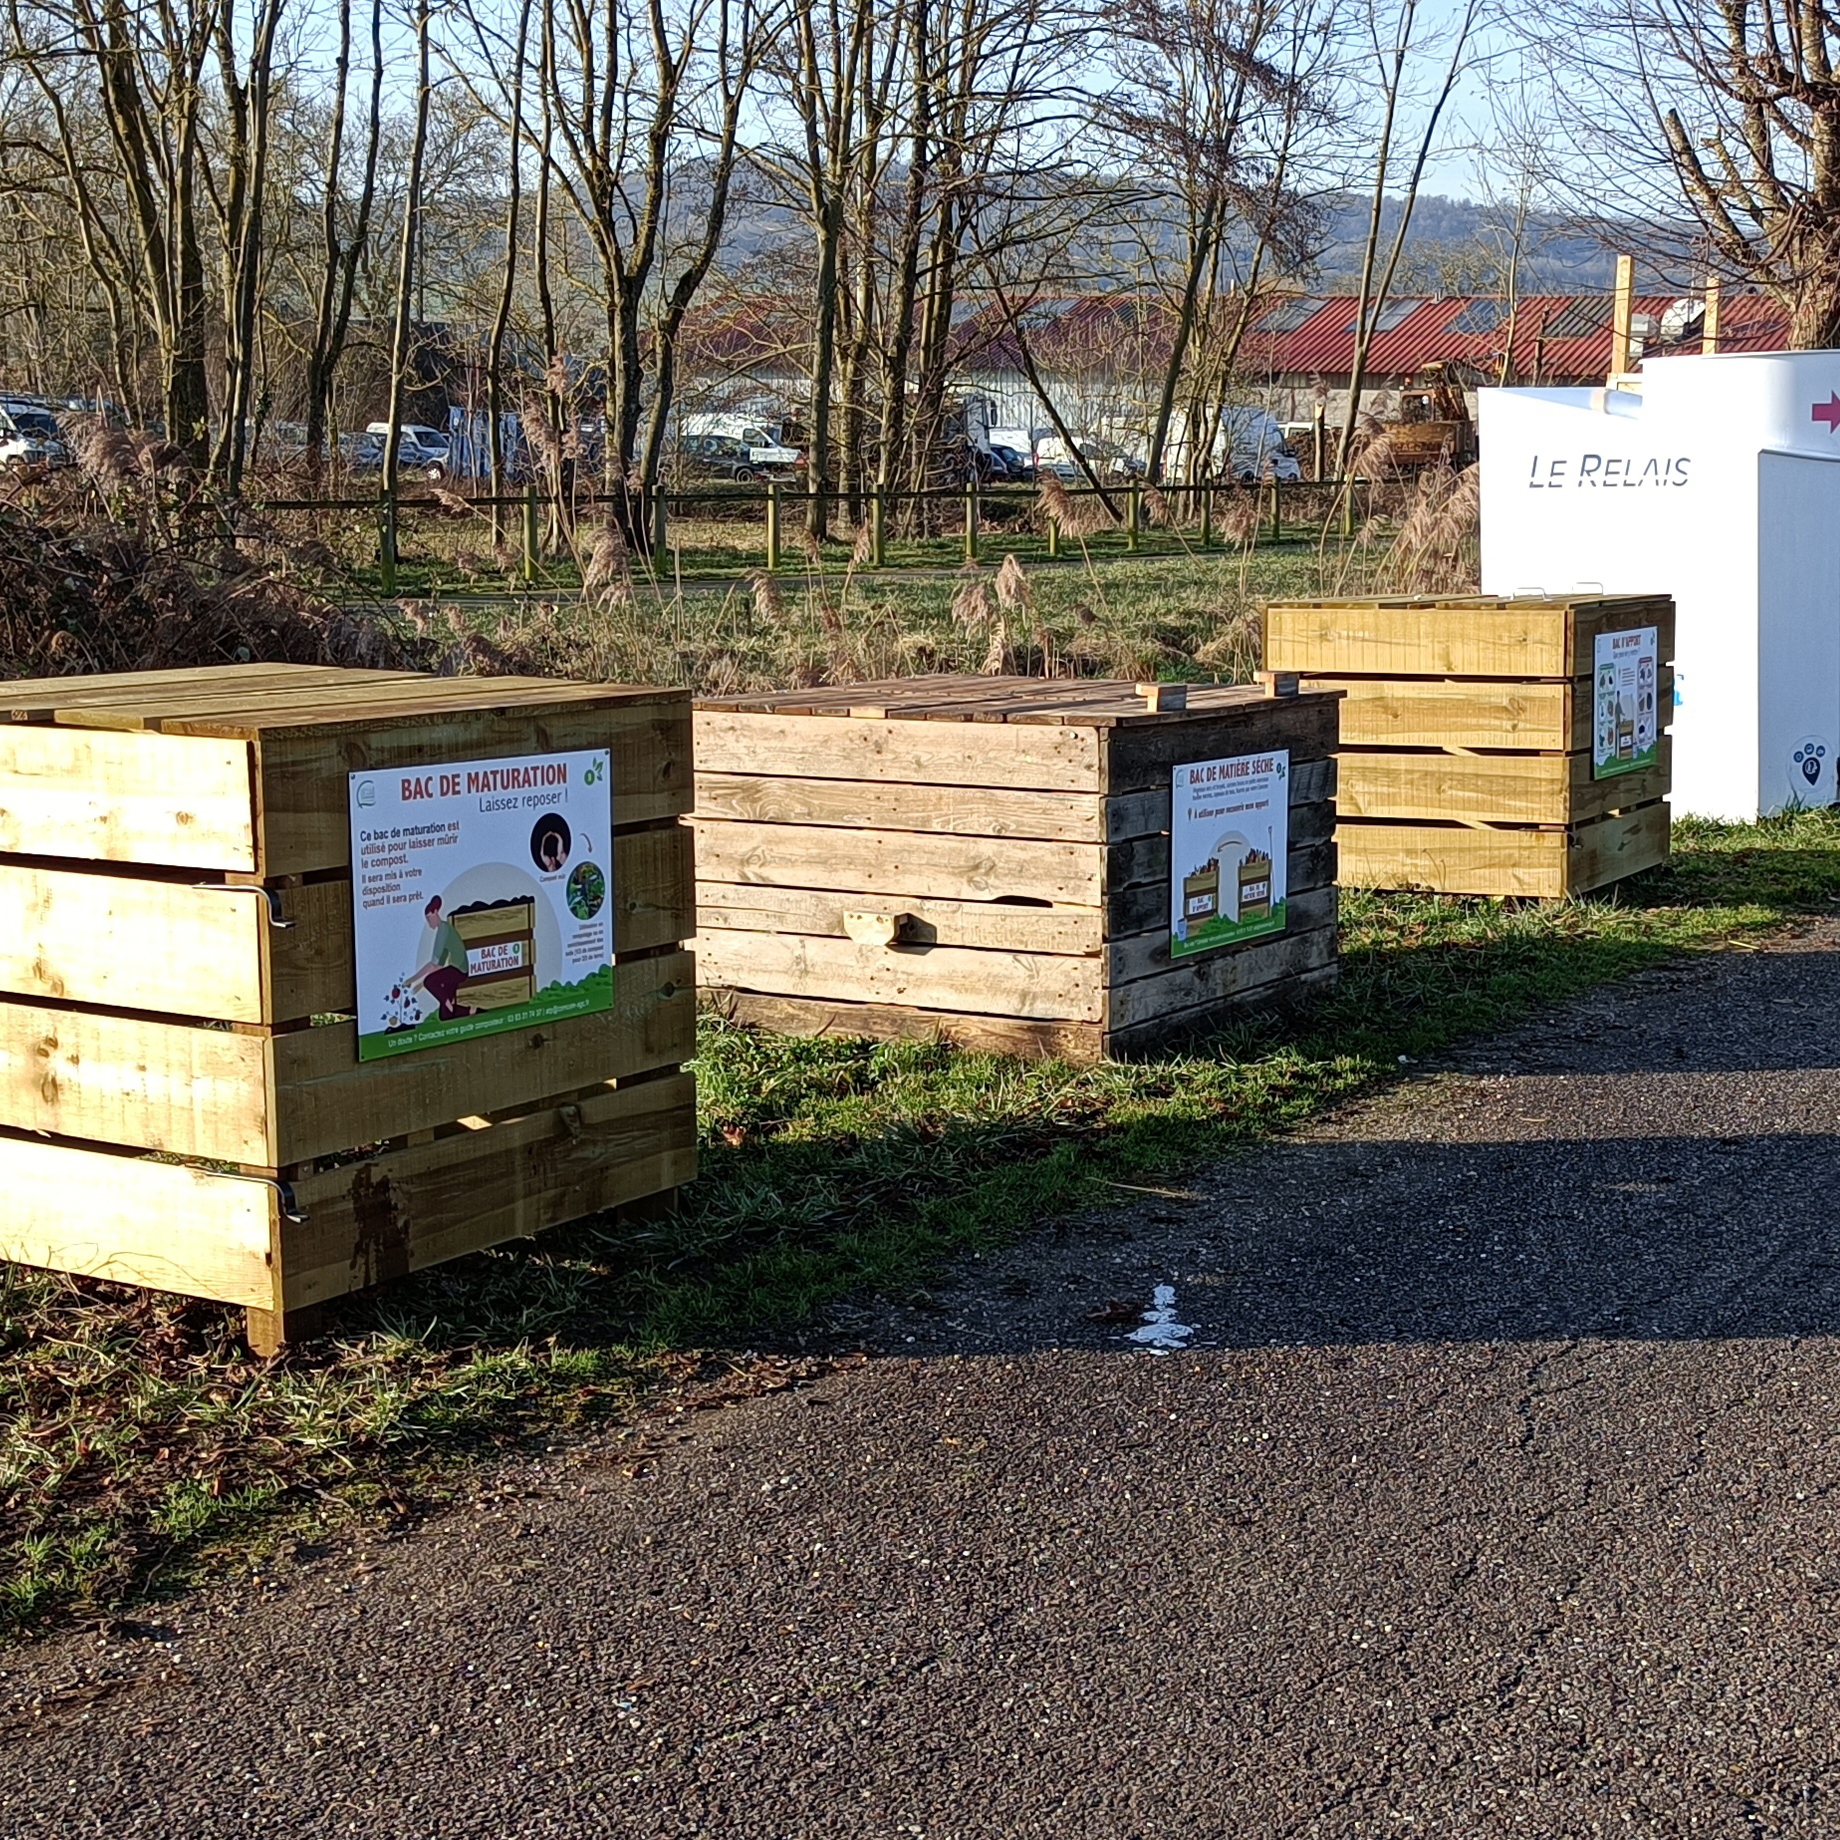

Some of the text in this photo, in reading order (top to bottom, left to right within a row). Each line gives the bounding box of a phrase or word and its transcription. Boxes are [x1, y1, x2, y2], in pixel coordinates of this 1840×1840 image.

[1529, 454, 1691, 488] LE RELAIS
[401, 776, 434, 800] BAC
[439, 773, 461, 796] DE
[467, 763, 567, 794] MATURATION
[1190, 768, 1204, 785] BAC
[1206, 766, 1217, 782] DE
[479, 788, 568, 812] Laissez reposer !
[360, 821, 459, 841] Ce bac de maturation est
[361, 833, 458, 855] utilisé pour laisser mûrir
[361, 853, 409, 868] le compost.
[368, 874, 383, 883] sera
[385, 871, 397, 880] mis
[405, 868, 422, 878] votre
[362, 882, 400, 896] disposition
[362, 896, 384, 909] quand
[392, 894, 407, 904] sera
[481, 945, 508, 959] BAC DE
[470, 956, 519, 974] MATURATION
[388, 1040, 396, 1048] Un
